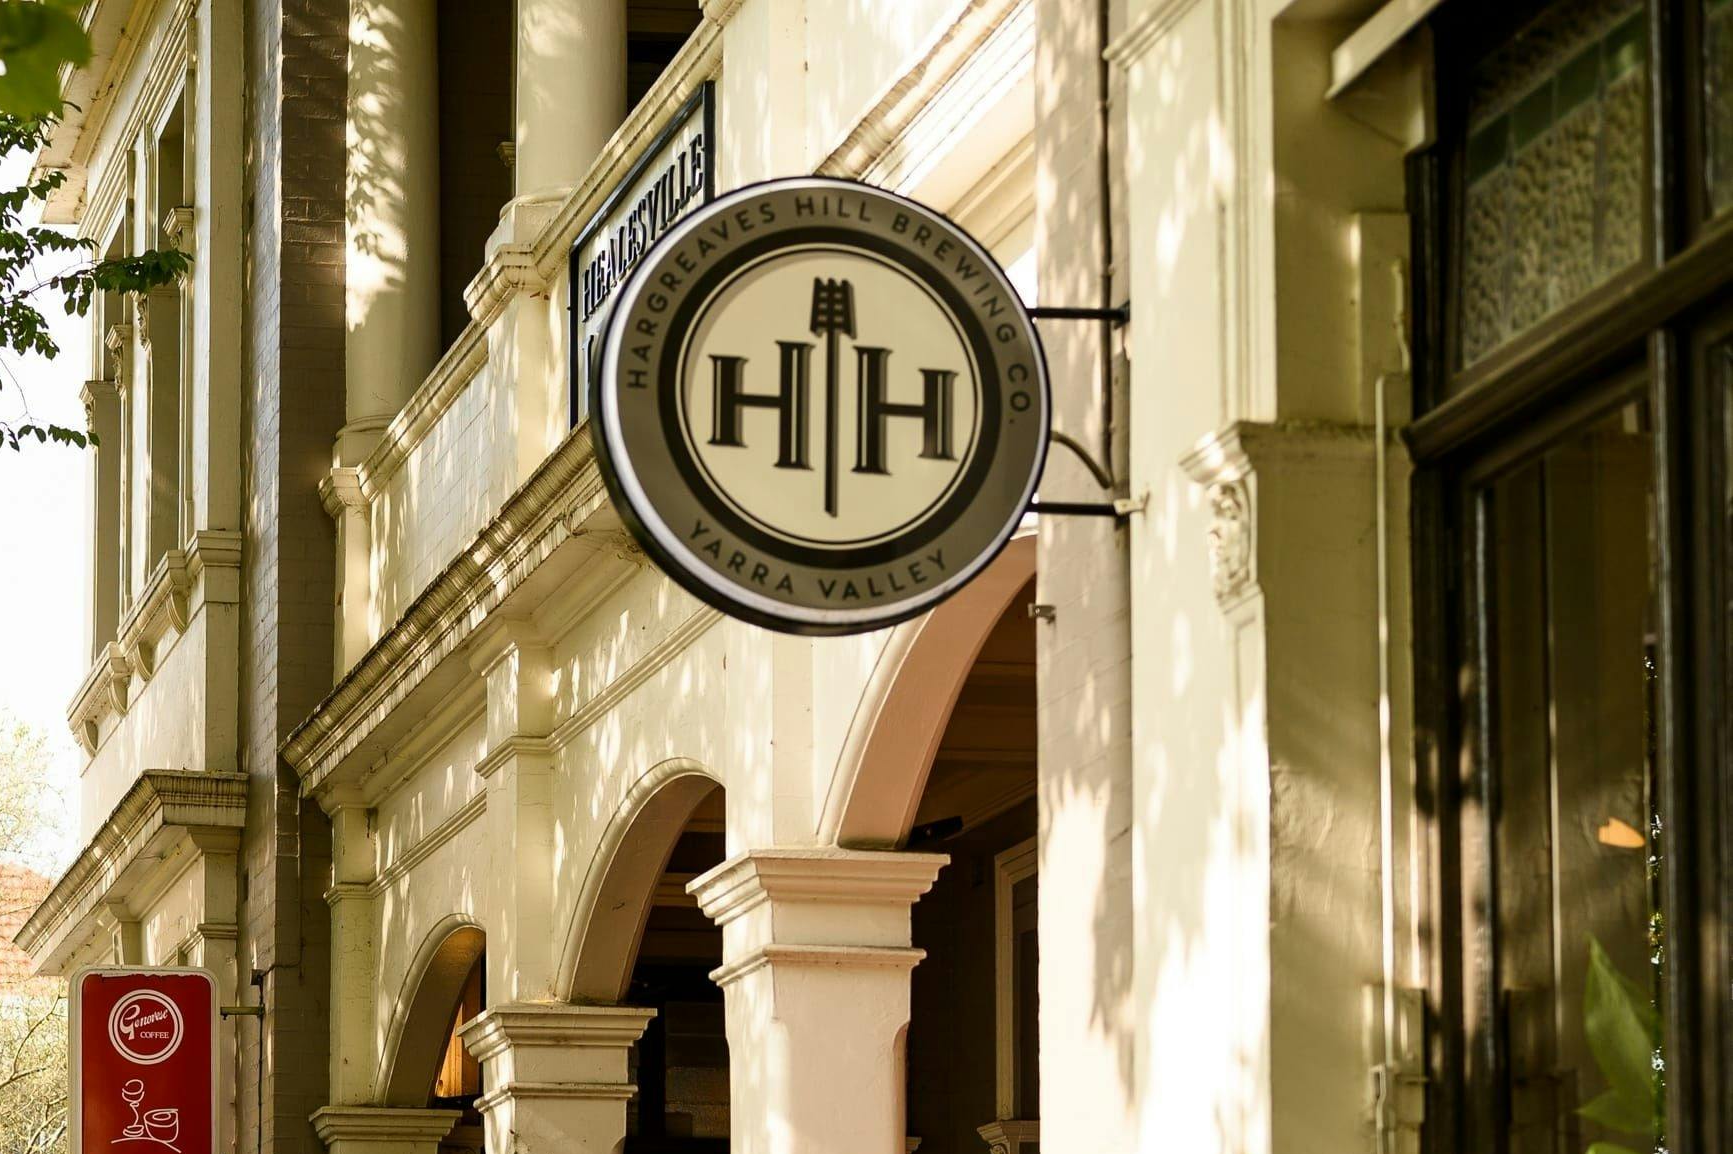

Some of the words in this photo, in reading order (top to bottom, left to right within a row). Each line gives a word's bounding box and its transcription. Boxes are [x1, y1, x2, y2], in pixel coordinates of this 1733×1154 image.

[582, 133, 703, 322] HEALESVILLE
[627, 202, 776, 389] HARGREAVES
[794, 195, 872, 223] HILL
[891, 213, 1016, 346] BREWING
[1006, 362, 1031, 425] CO.
[691, 519, 793, 595] YARRA
[818, 548, 947, 601] VALLEY
[139, 1031, 170, 1039] COFFEE
